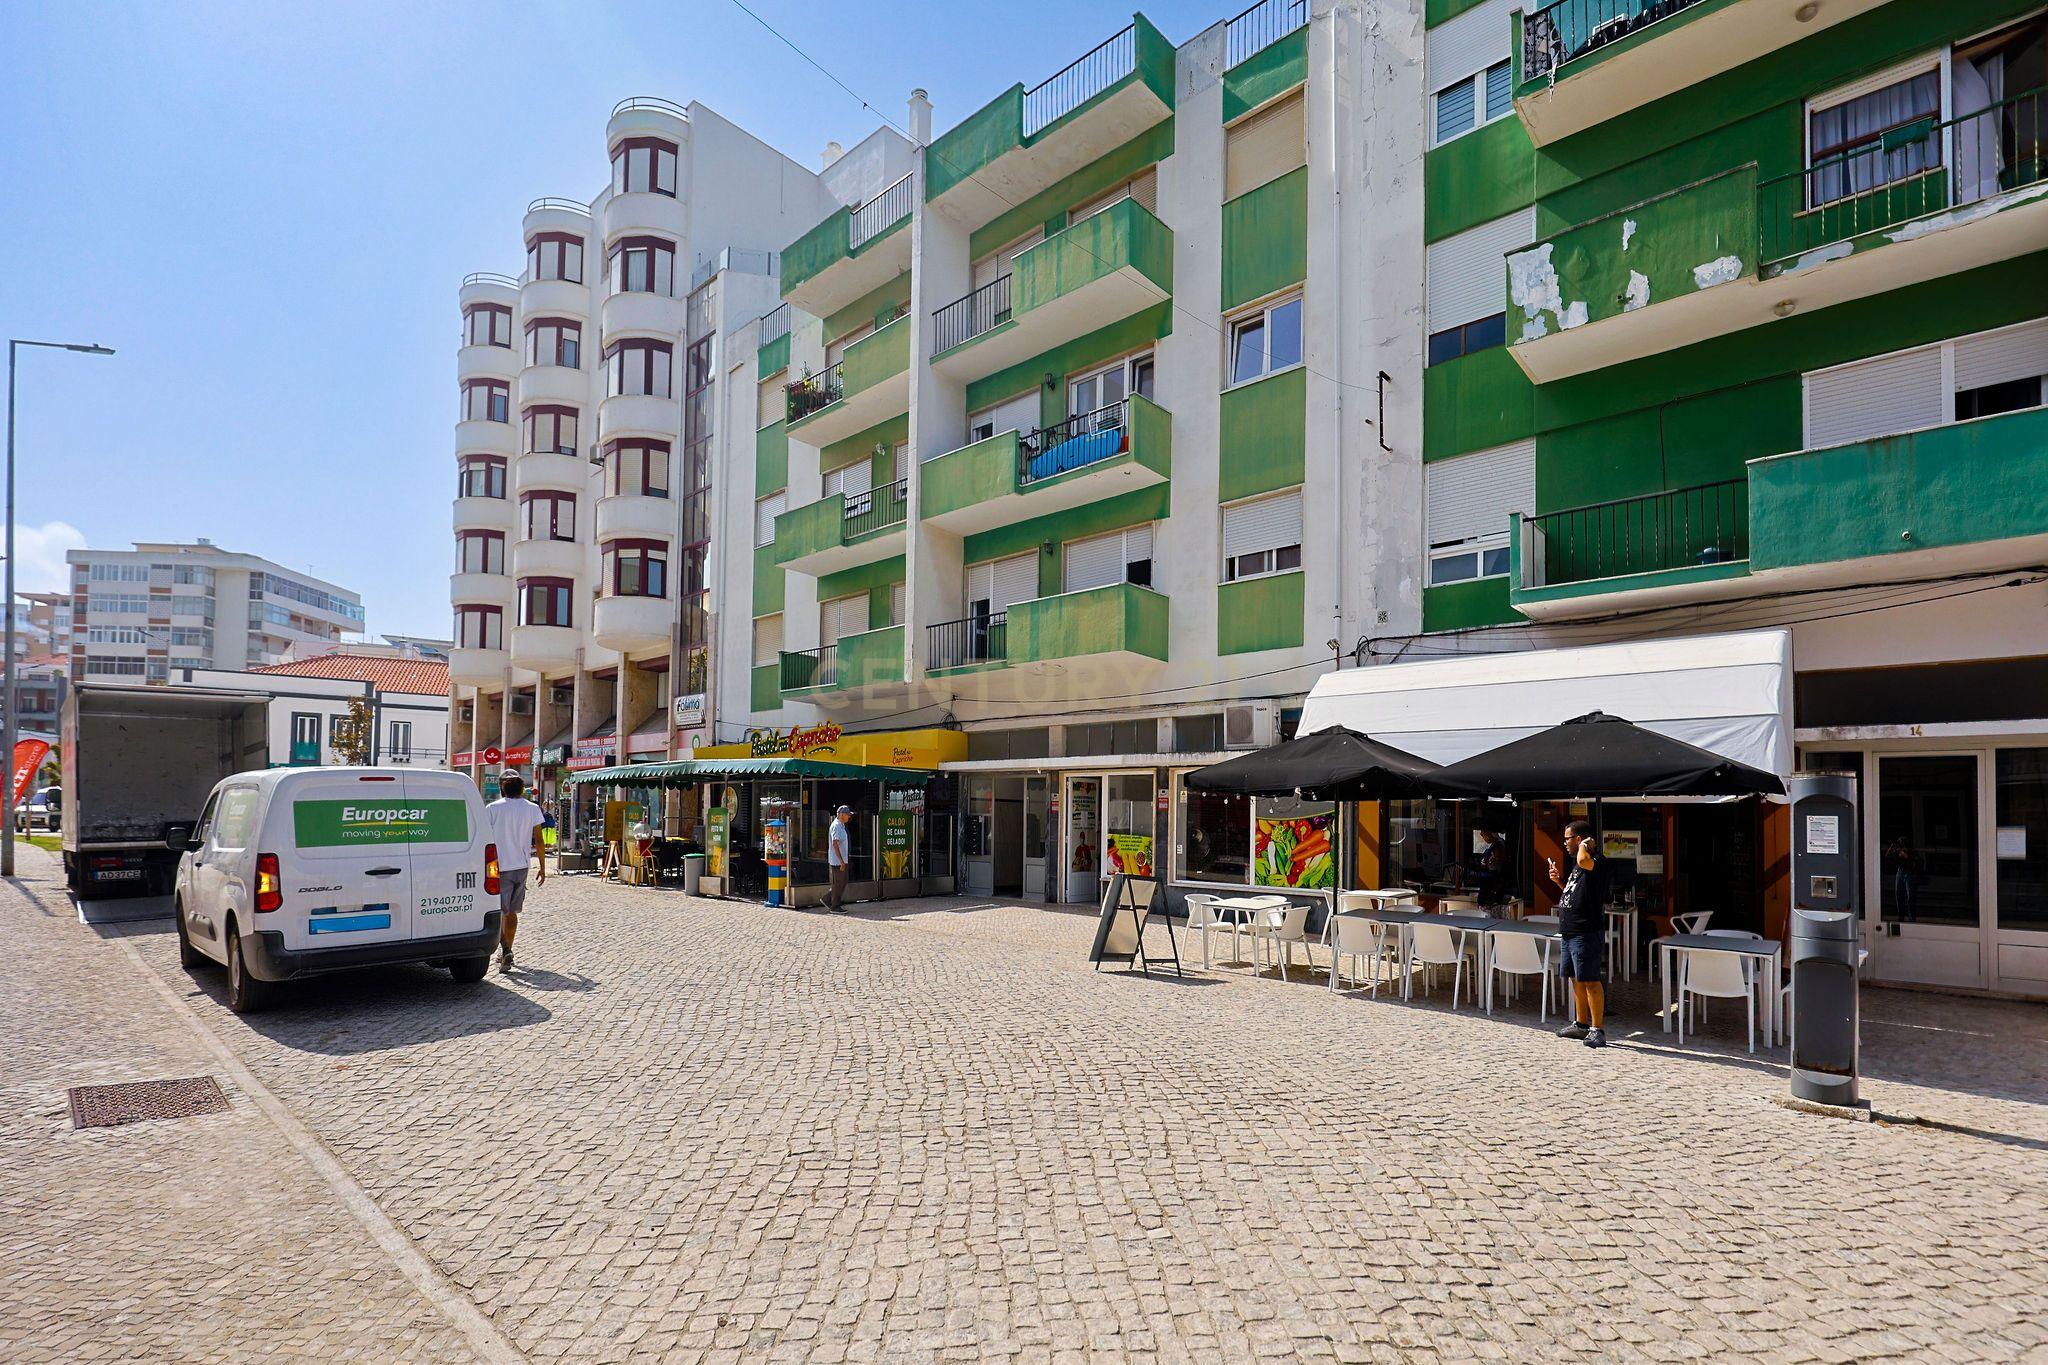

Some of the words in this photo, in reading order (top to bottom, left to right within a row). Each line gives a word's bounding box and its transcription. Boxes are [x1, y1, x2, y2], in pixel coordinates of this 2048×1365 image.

[1910, 724, 1922, 737] 14
[788, 720, 842, 759] Capricho
[341, 806, 429, 826] Europcar
[887, 817, 906, 826] CALDO
[342, 829, 381, 839] moving
[383, 829, 407, 838] your
[408, 828, 430, 838] way
[886, 828, 893, 836] DE
[893, 828, 906, 836] CANA
[456, 871, 477, 890] FIAT
[420, 894, 474, 907] 219407790
[420, 903, 474, 916] europcar.pt
